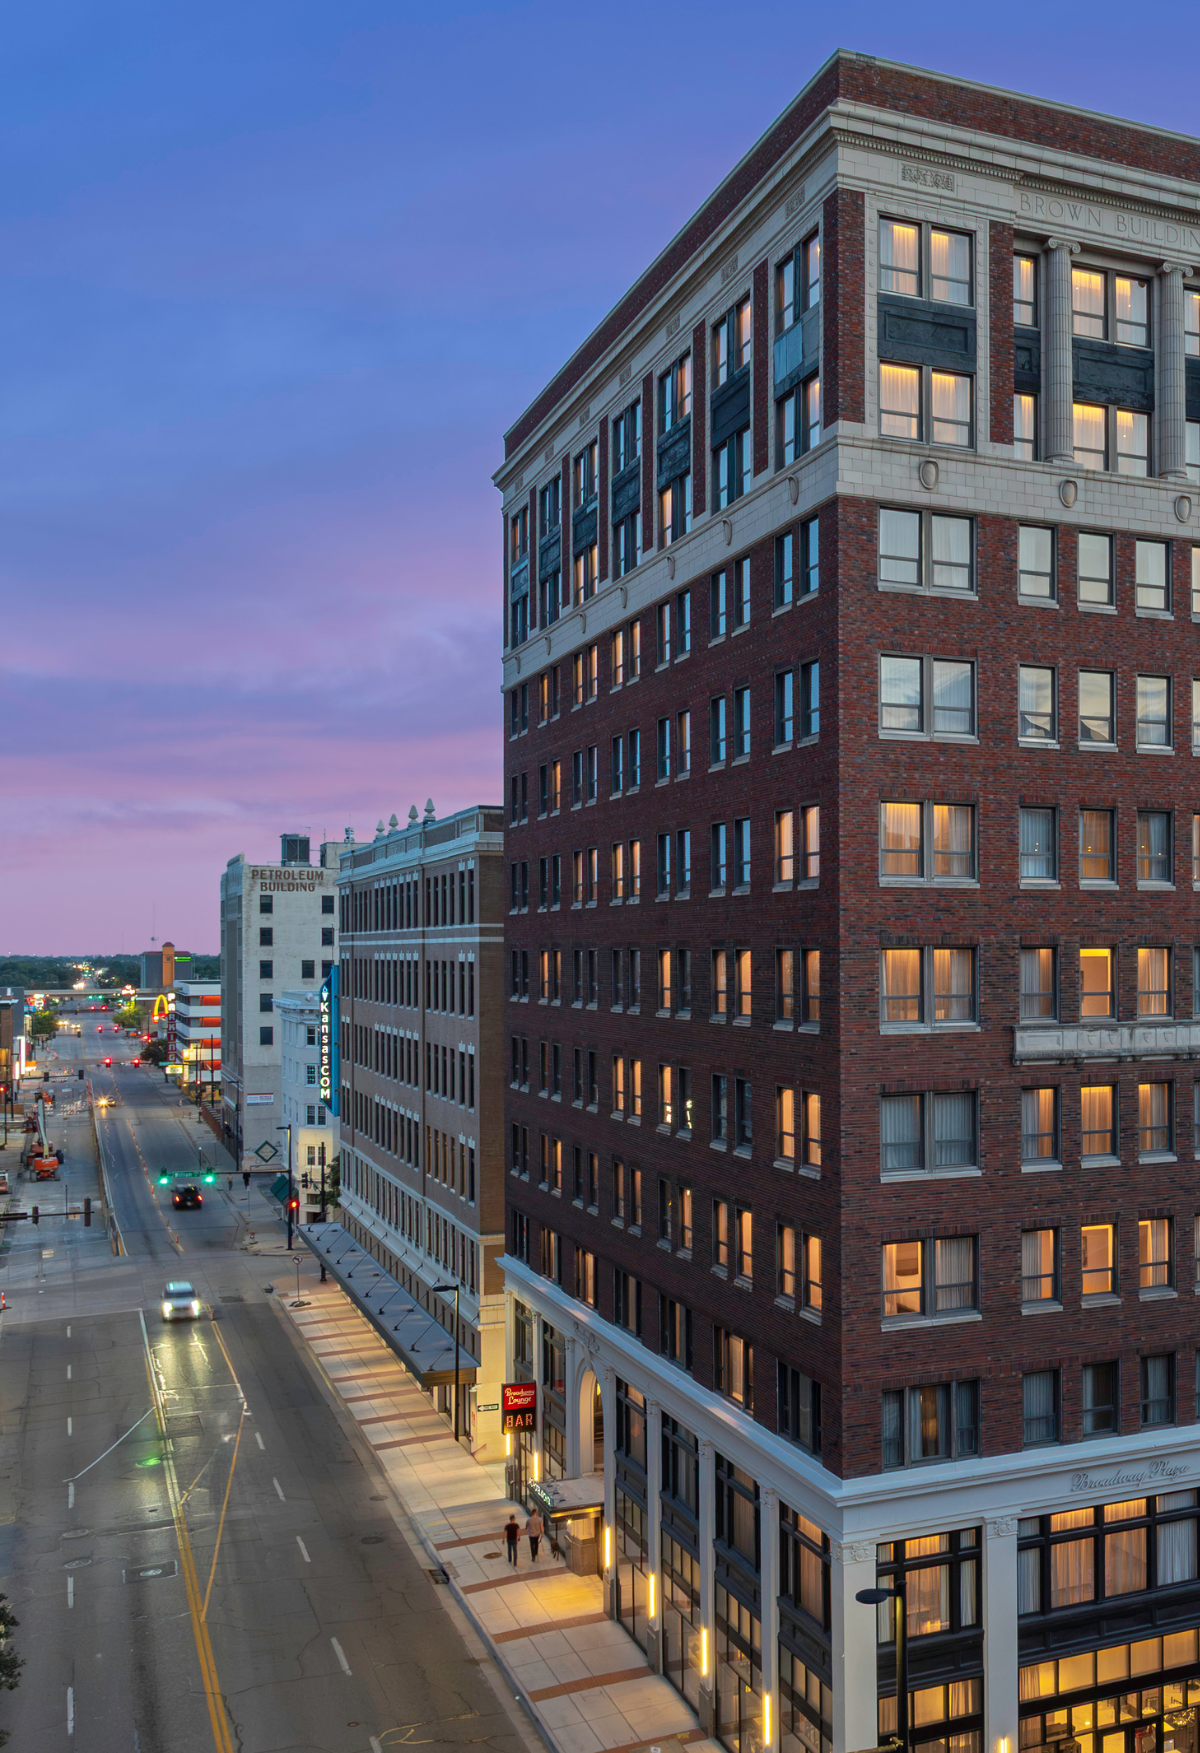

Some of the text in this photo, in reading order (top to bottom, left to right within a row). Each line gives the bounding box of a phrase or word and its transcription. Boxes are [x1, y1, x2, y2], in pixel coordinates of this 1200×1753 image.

[1020, 193, 1101, 228] BROWN
[251, 869, 324, 880] PETROLEUM
[260, 881, 316, 893] BUILDING
[167, 992, 176, 1062] PARKING
[505, 1388, 535, 1397] Broadway
[508, 1396, 531, 1405] Lounge
[506, 1413, 533, 1428] BAR
[1071, 1459, 1191, 1492] Broadway Plaza
